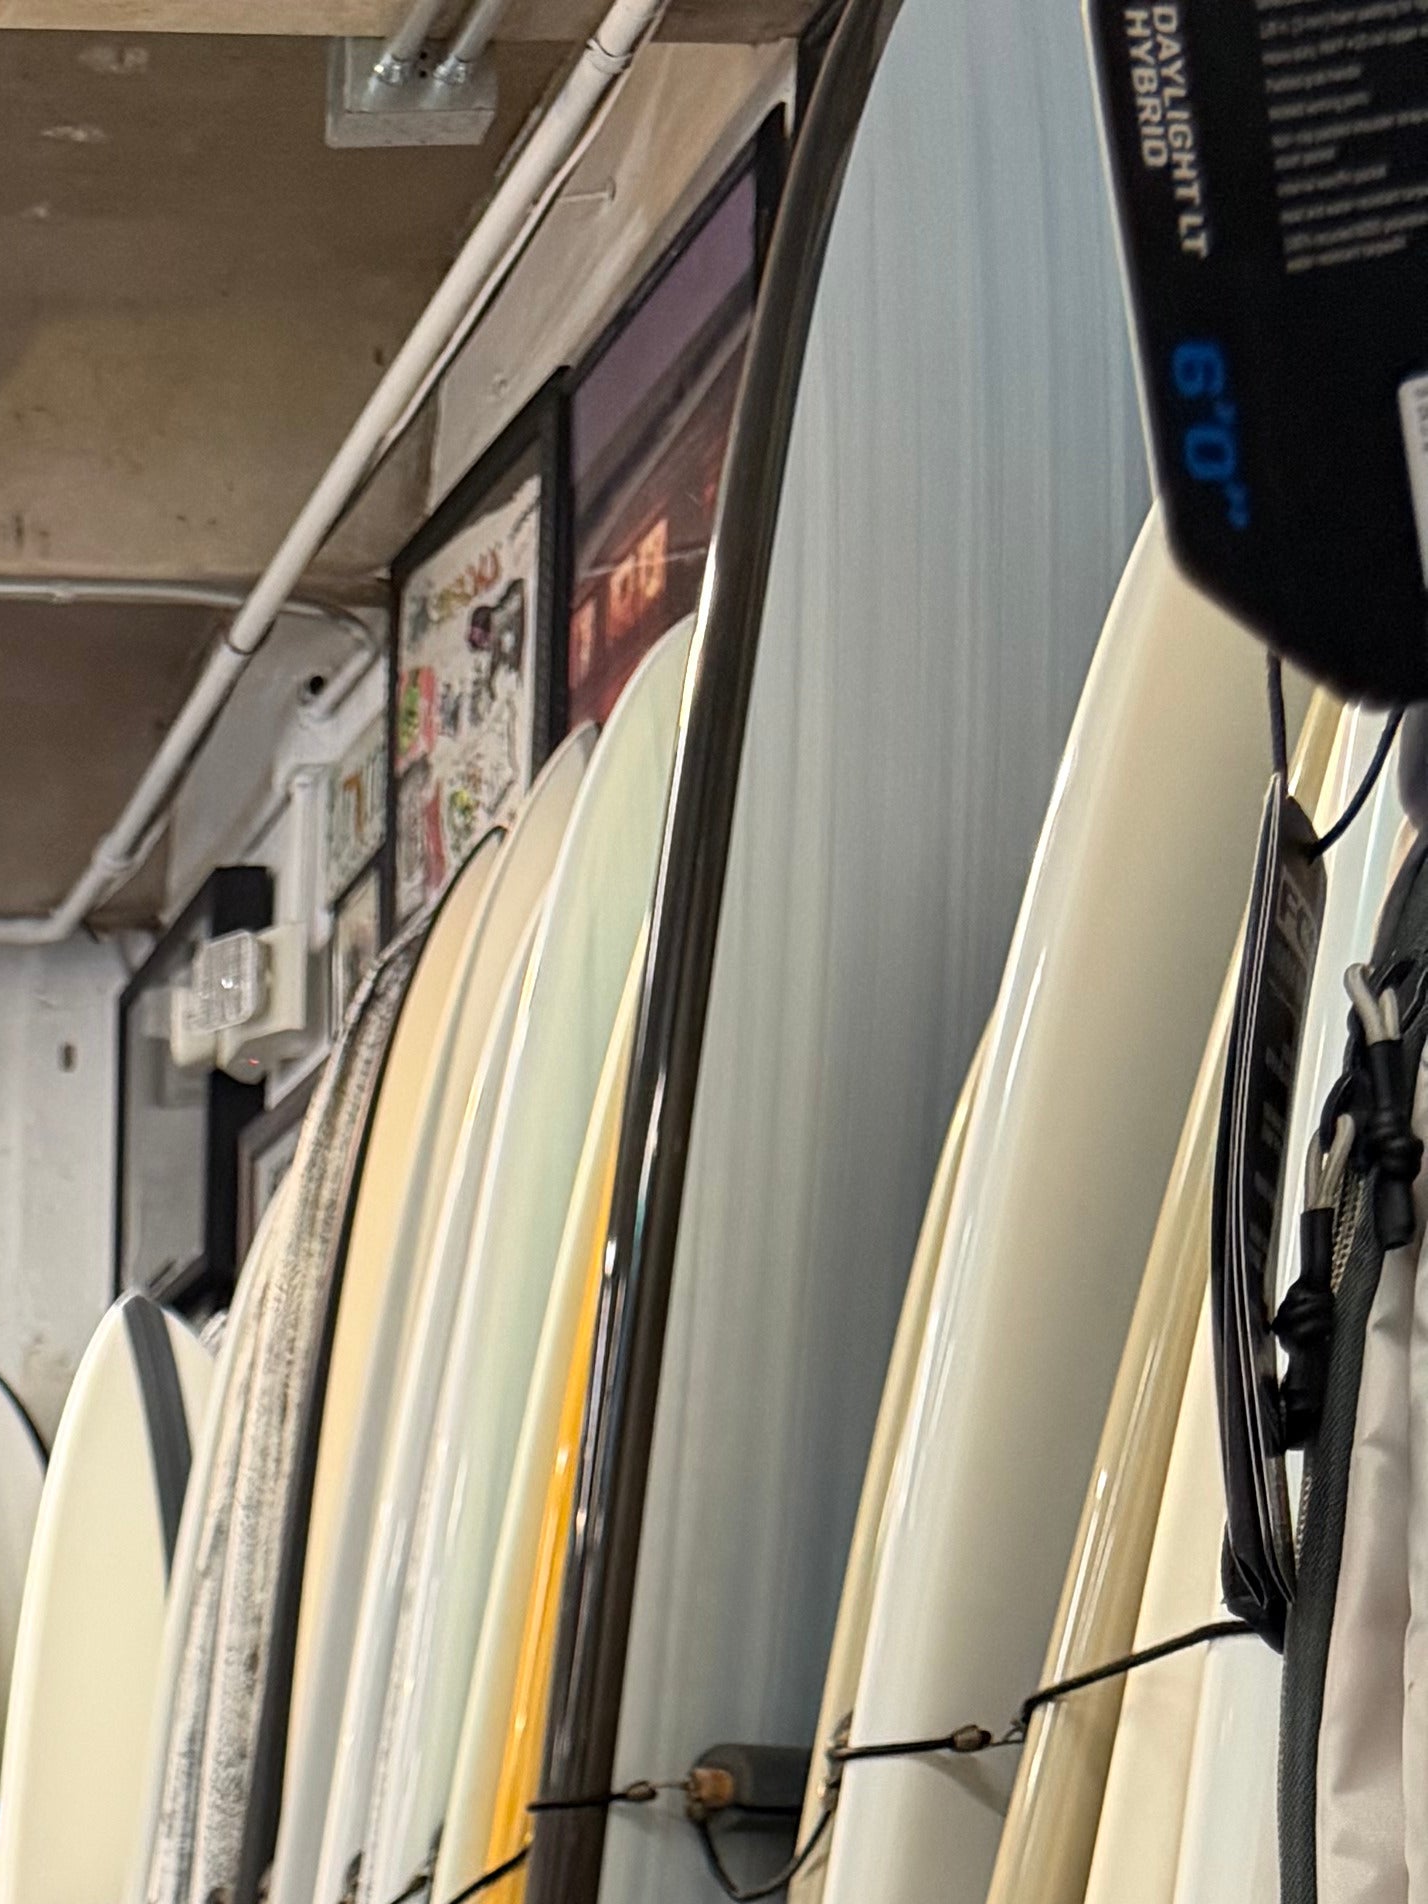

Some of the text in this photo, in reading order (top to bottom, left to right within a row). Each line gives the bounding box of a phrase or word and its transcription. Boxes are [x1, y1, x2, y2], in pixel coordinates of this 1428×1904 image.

[1123, 9, 1168, 168] HYBRID
[1153, 4, 1208, 259] DAYLIGHT LT
